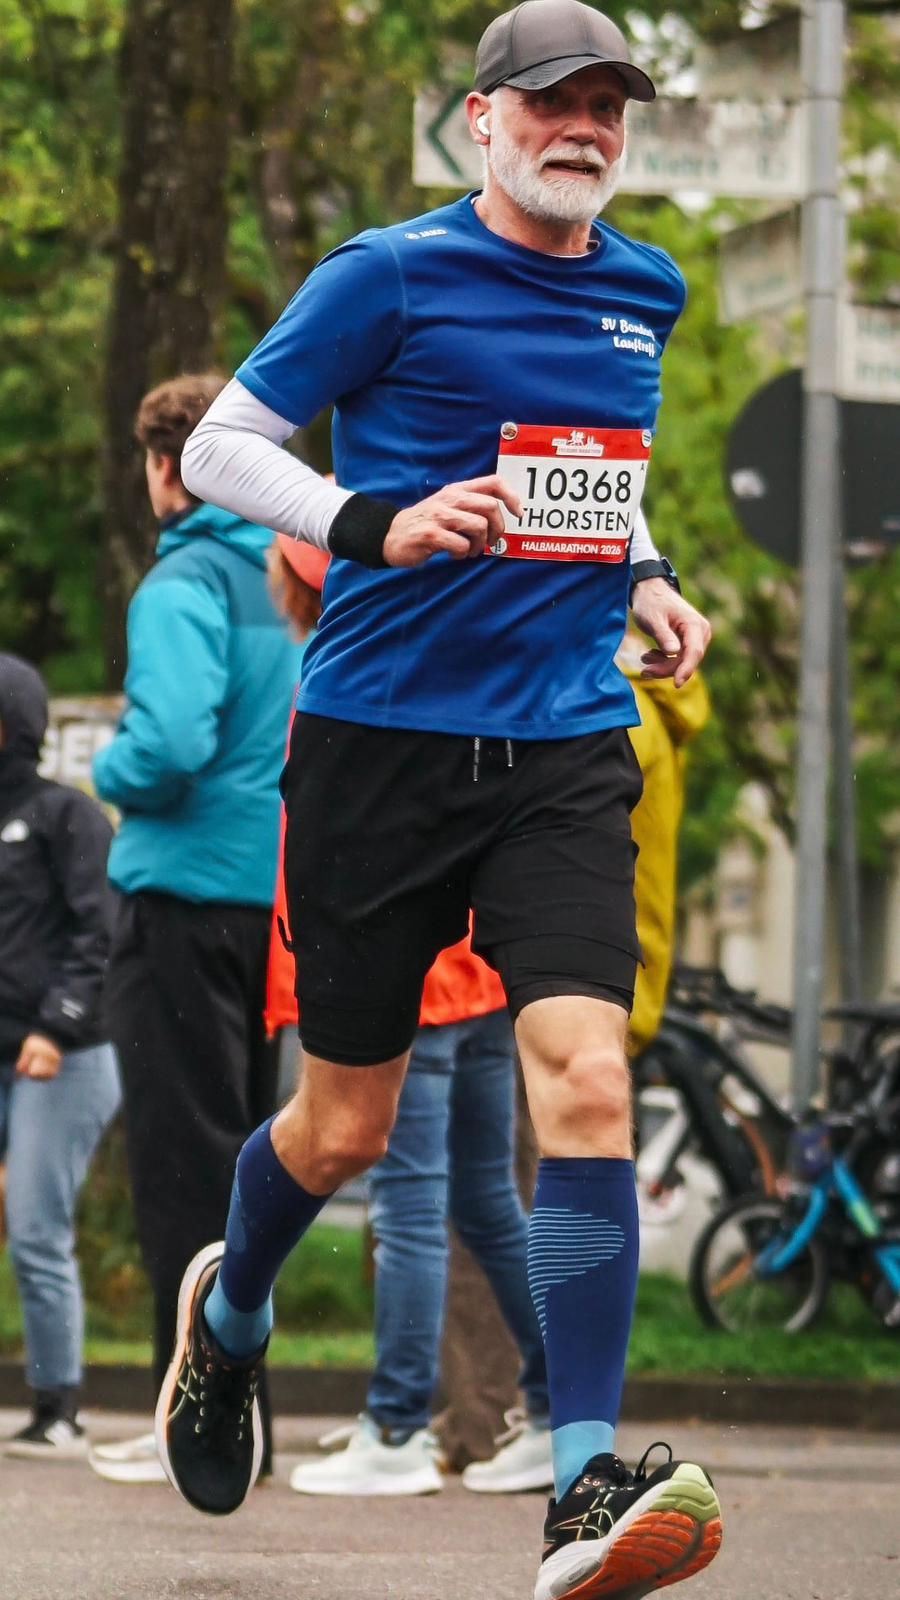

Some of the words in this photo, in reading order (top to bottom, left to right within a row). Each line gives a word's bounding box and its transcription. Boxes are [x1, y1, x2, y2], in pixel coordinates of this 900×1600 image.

[601, 317, 616, 331] SV
[613, 335, 656, 358] Lauftreff
[526, 467, 632, 503] 10368
[521, 541, 599, 554] HALBMARATHON
[600, 544, 621, 555] 2026
